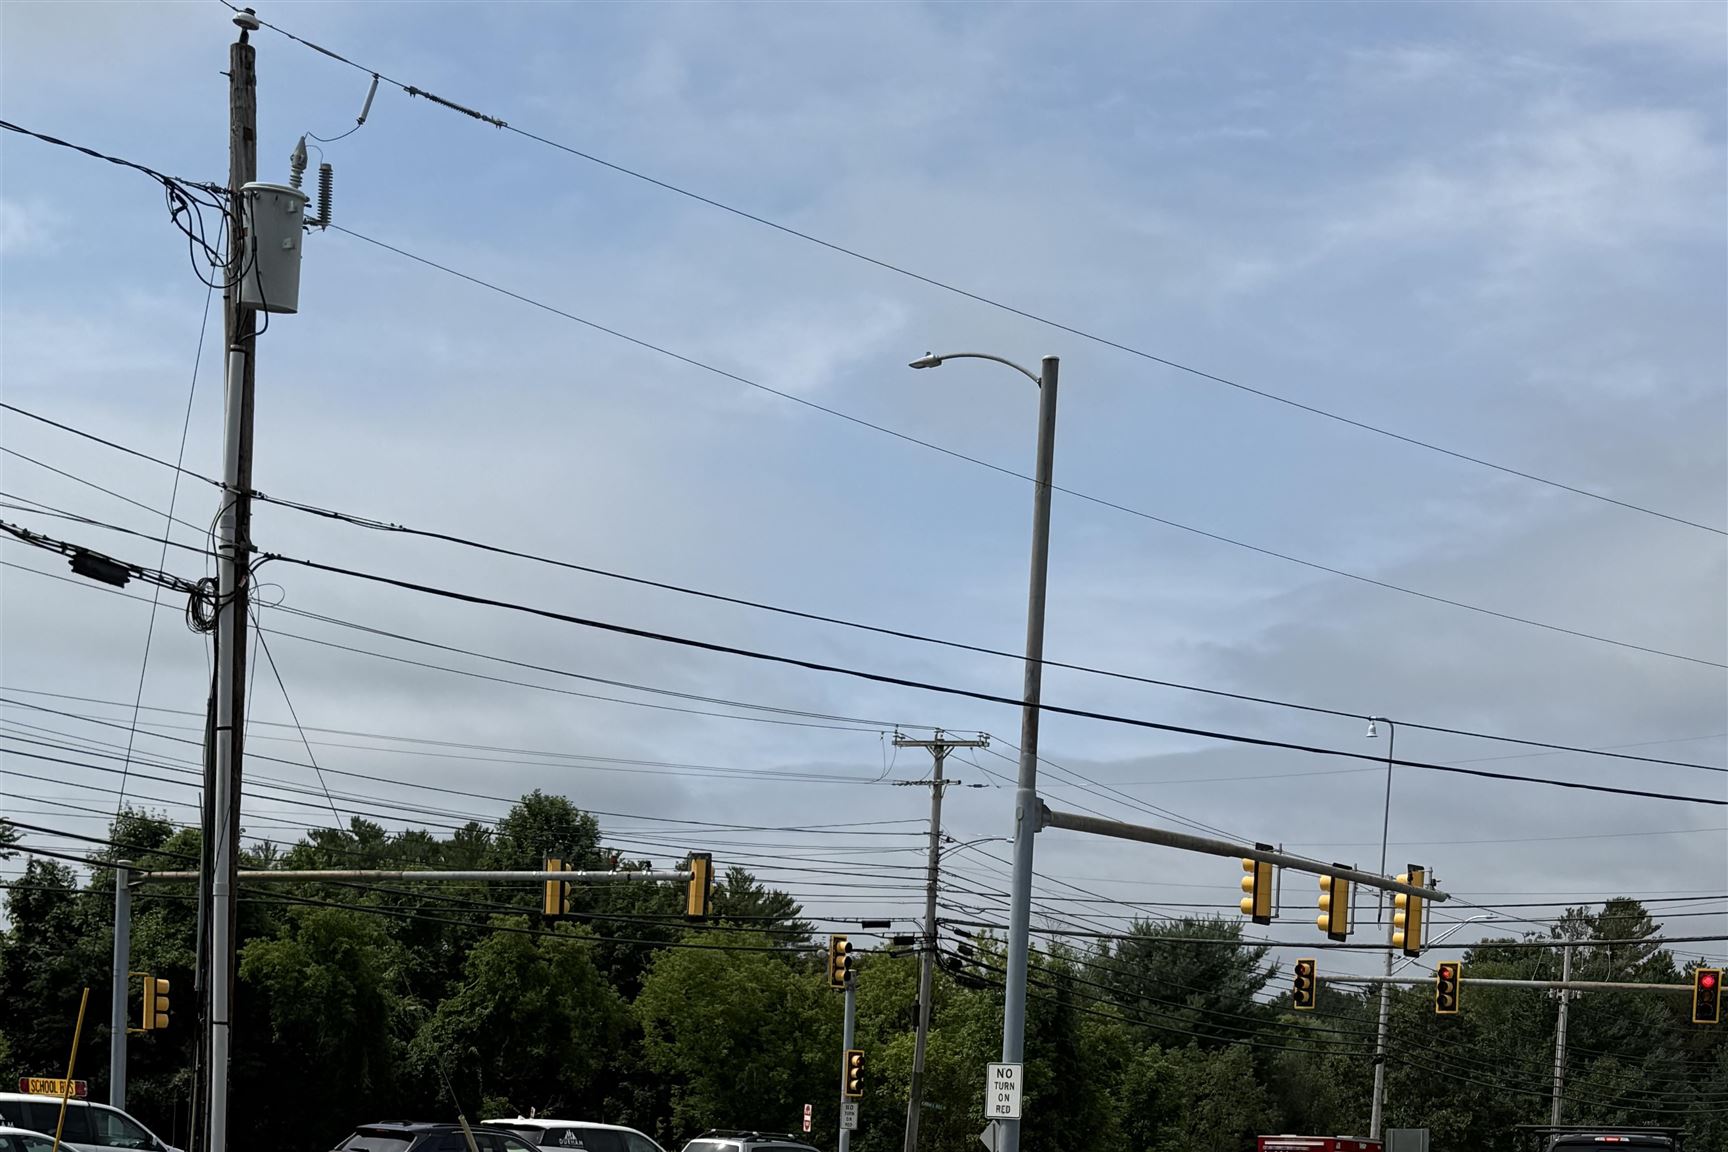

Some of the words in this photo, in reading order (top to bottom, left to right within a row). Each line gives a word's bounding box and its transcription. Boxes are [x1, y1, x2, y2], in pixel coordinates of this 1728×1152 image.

[996, 1068, 1013, 1079] NO
[30, 1079, 58, 1093] SCHOOL
[994, 1081, 1015, 1091] TURN
[998, 1093, 1010, 1102] ON
[995, 1105, 1011, 1114] RED
